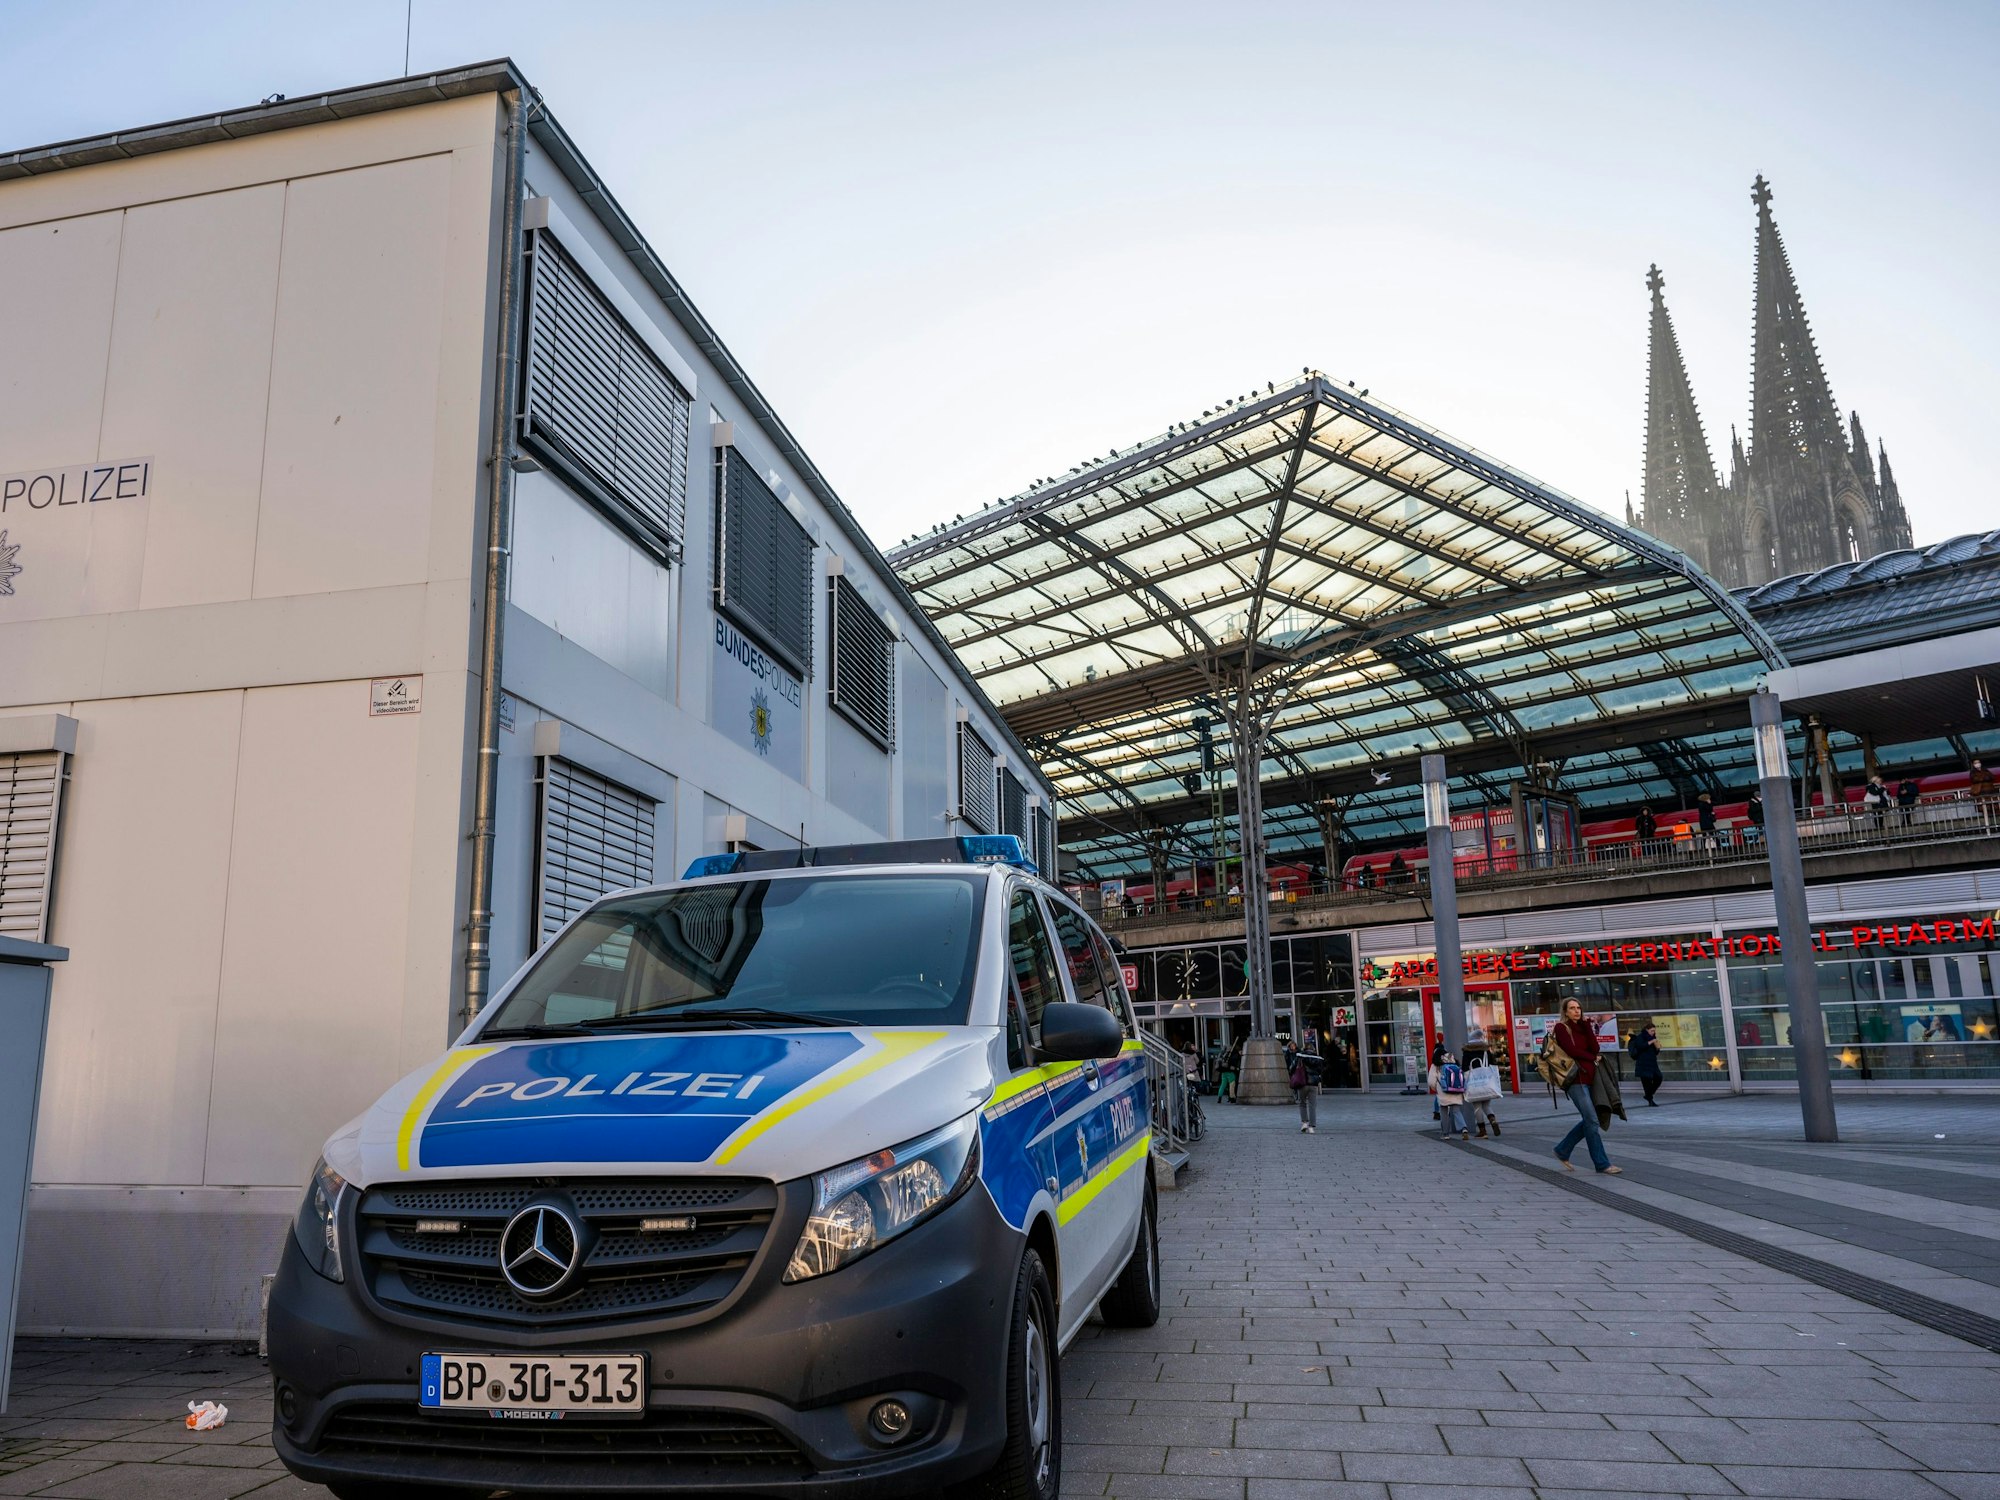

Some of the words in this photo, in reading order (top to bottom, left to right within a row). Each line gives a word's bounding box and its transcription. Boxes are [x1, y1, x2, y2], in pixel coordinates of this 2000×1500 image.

[2, 463, 148, 512] POLIZEI
[716, 618, 801, 710] BUNDESPOLIZEI
[1390, 952, 1527, 978] APOHEKE
[1571, 930, 1837, 967] INTERNATIONL
[1852, 917, 1995, 949] PHARM
[456, 1072, 765, 1109] POLIZEI
[1110, 1096, 1135, 1145] POLIZEI
[427, 1385, 436, 1397] D
[443, 1362, 487, 1400] BP
[508, 1363, 638, 1402] 30-313
[504, 1410, 551, 1419] MOSOLF
